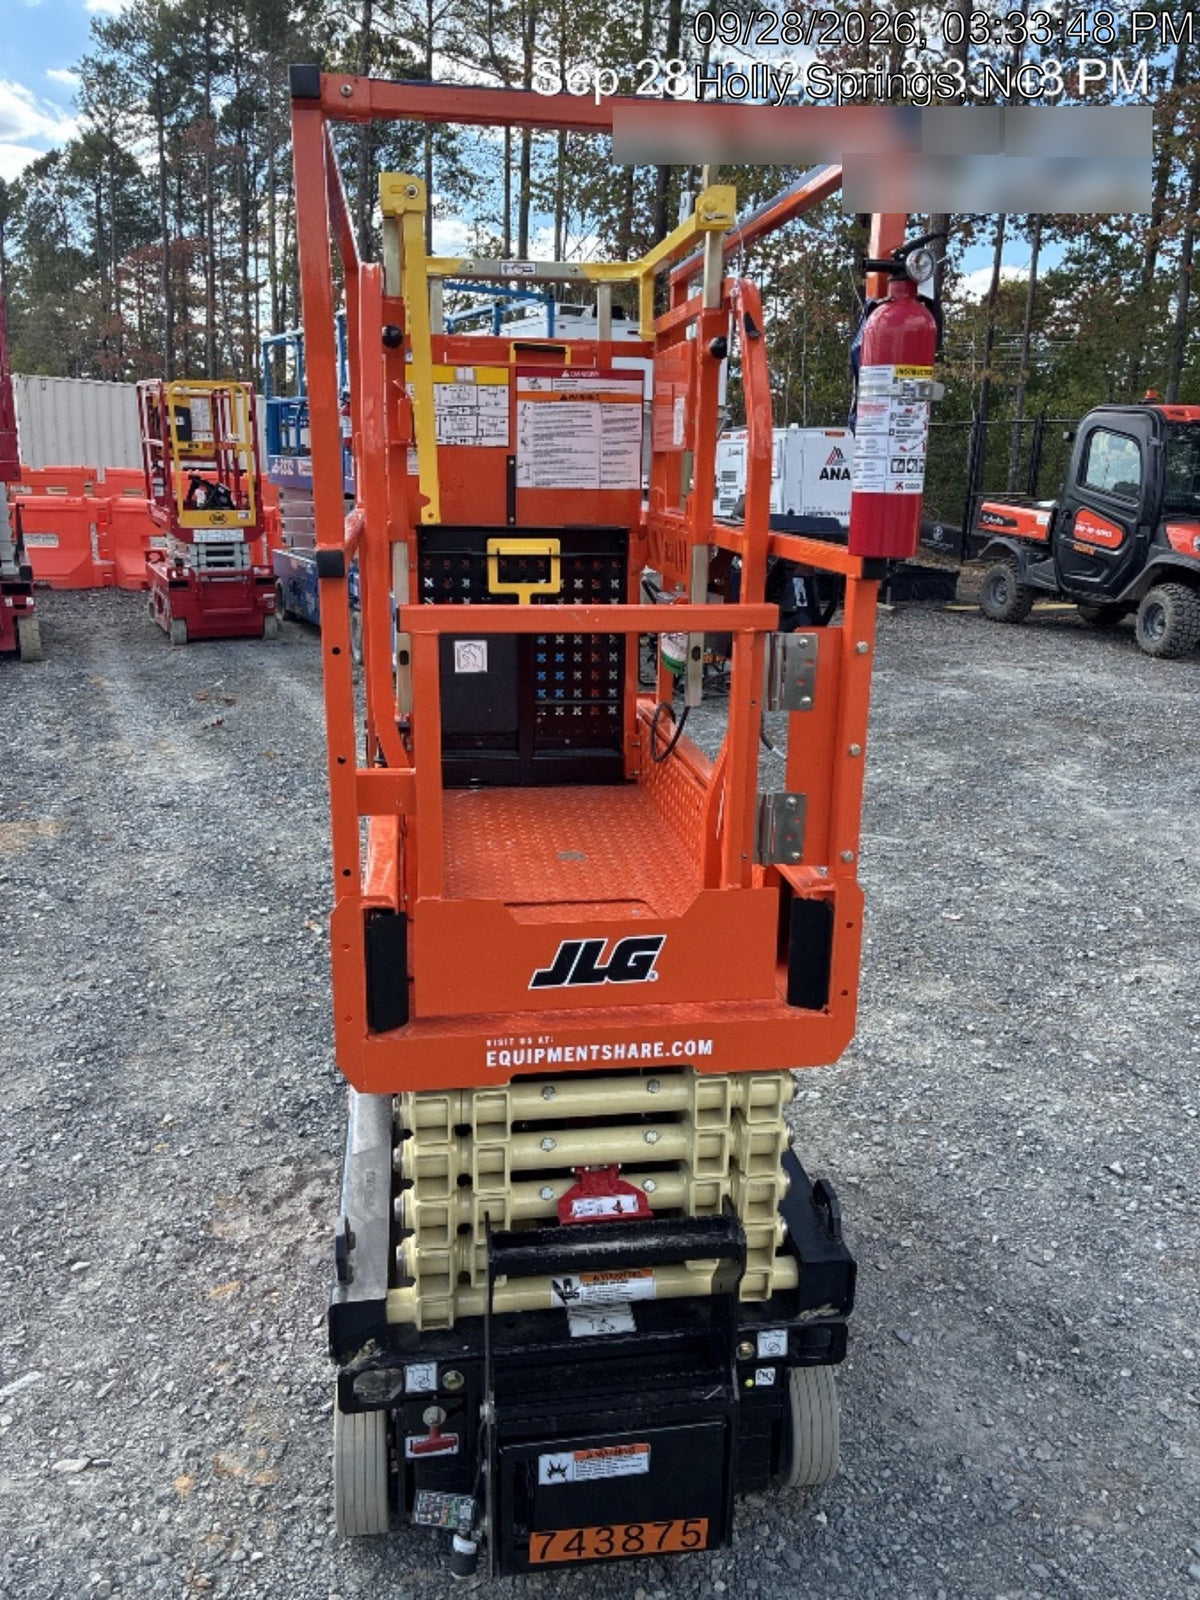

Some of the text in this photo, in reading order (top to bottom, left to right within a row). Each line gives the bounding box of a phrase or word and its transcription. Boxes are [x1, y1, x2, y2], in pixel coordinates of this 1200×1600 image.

[819, 466, 851, 481] ANA
[528, 934, 667, 990] JLG
[486, 1039, 713, 1068] EQUIPMENTSHARE.COM
[535, 1519, 702, 1560] 743875
